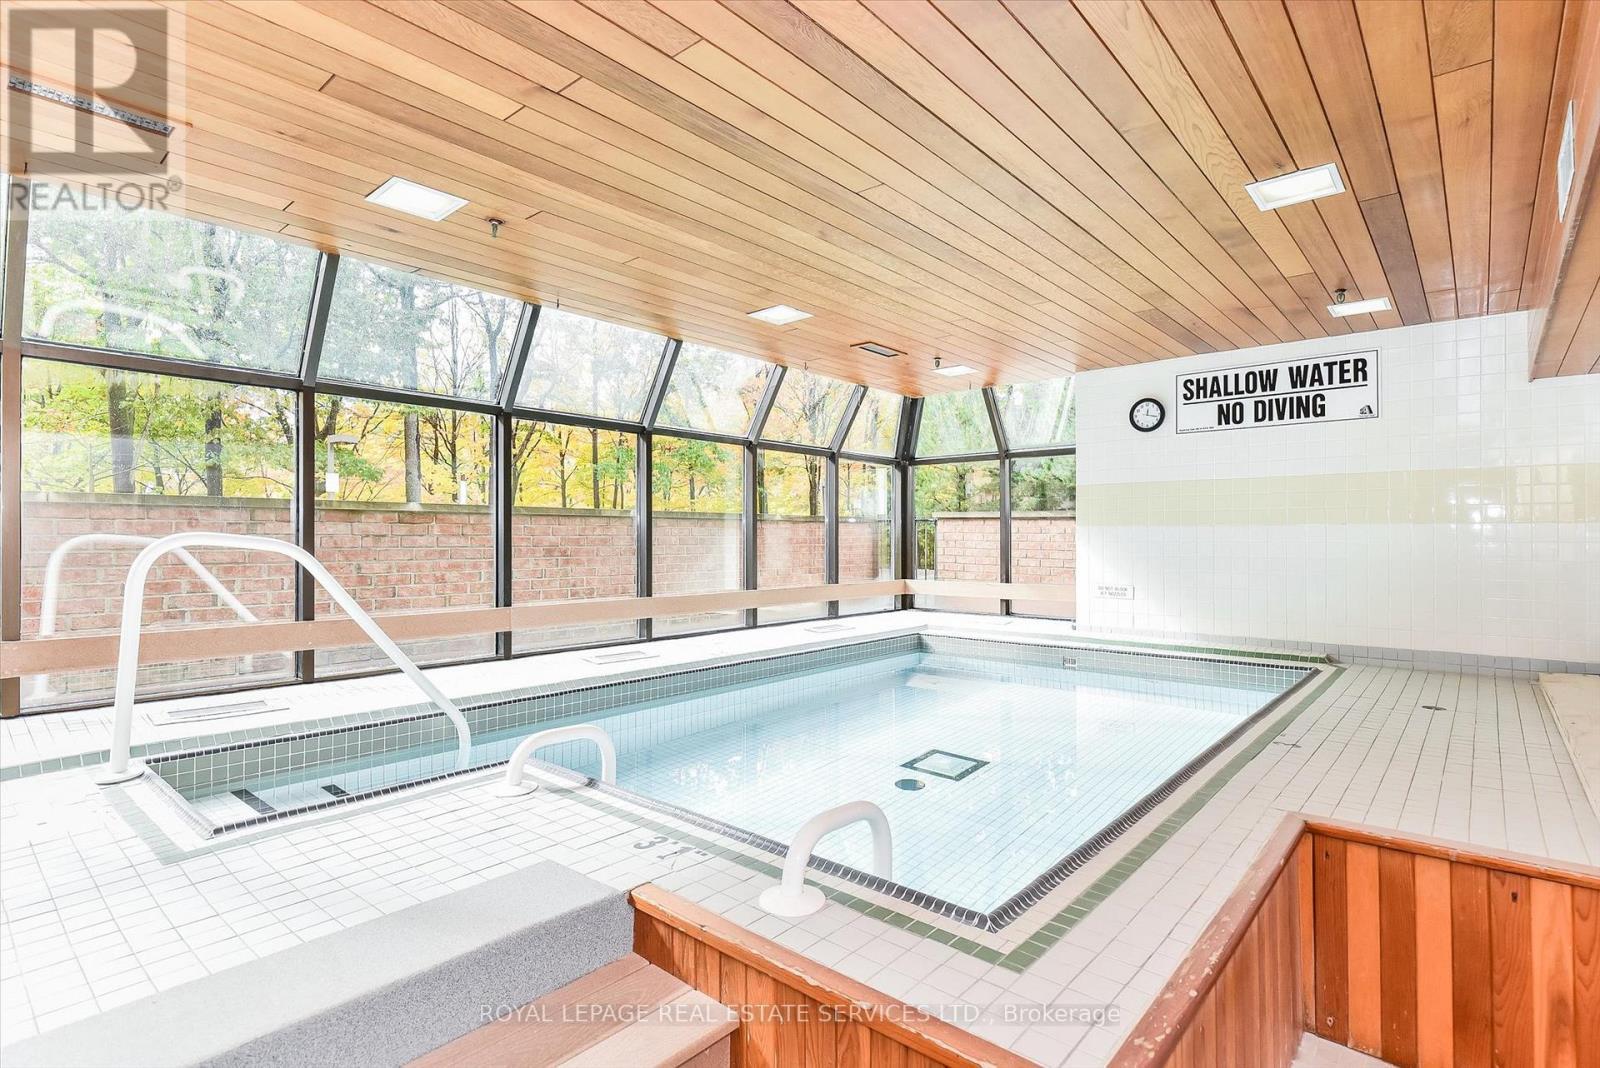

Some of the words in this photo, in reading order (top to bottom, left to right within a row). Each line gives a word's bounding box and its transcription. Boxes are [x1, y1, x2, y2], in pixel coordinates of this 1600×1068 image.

[1183, 368, 1279, 401] SHALLOW
[1289, 357, 1368, 390] WATER
[1217, 402, 1245, 426] NO
[1254, 394, 1326, 423] DIVING
